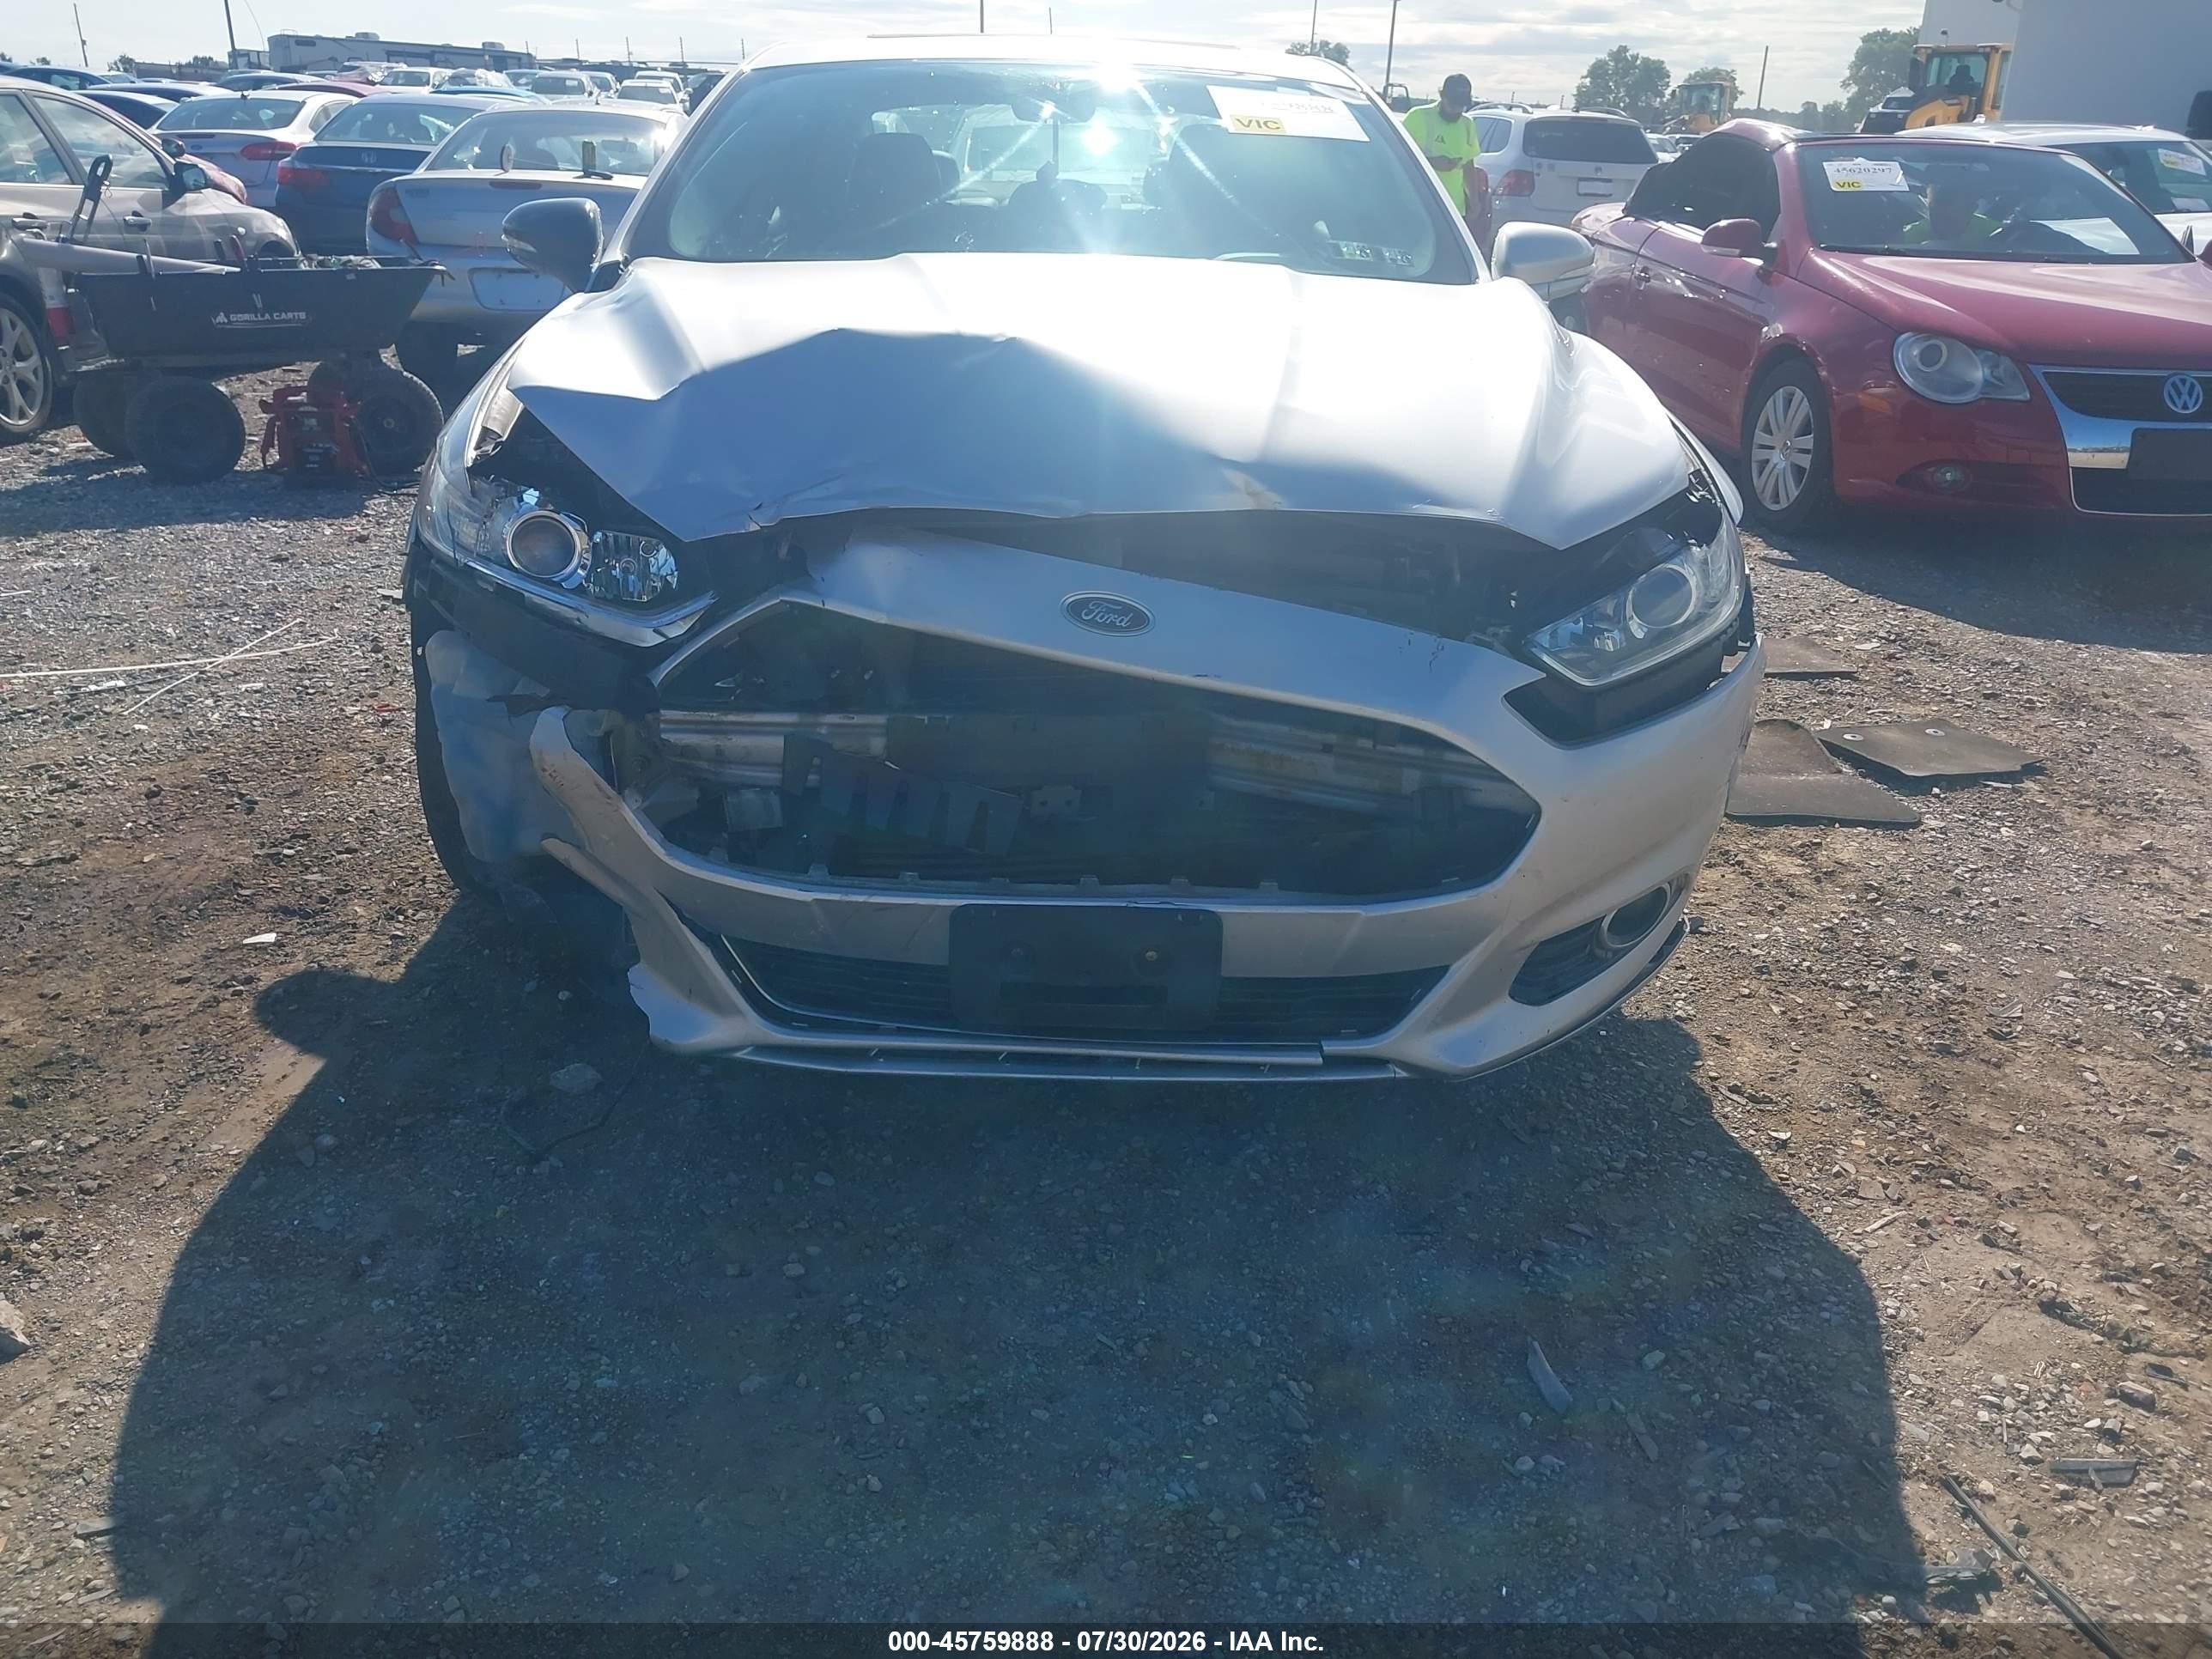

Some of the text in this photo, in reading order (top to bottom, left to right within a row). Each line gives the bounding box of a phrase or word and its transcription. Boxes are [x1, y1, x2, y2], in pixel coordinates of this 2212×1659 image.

[1234, 117, 1282, 131] VIC
[229, 311, 307, 322] GORILLA CARTS
[1080, 599, 1133, 628] Ford
